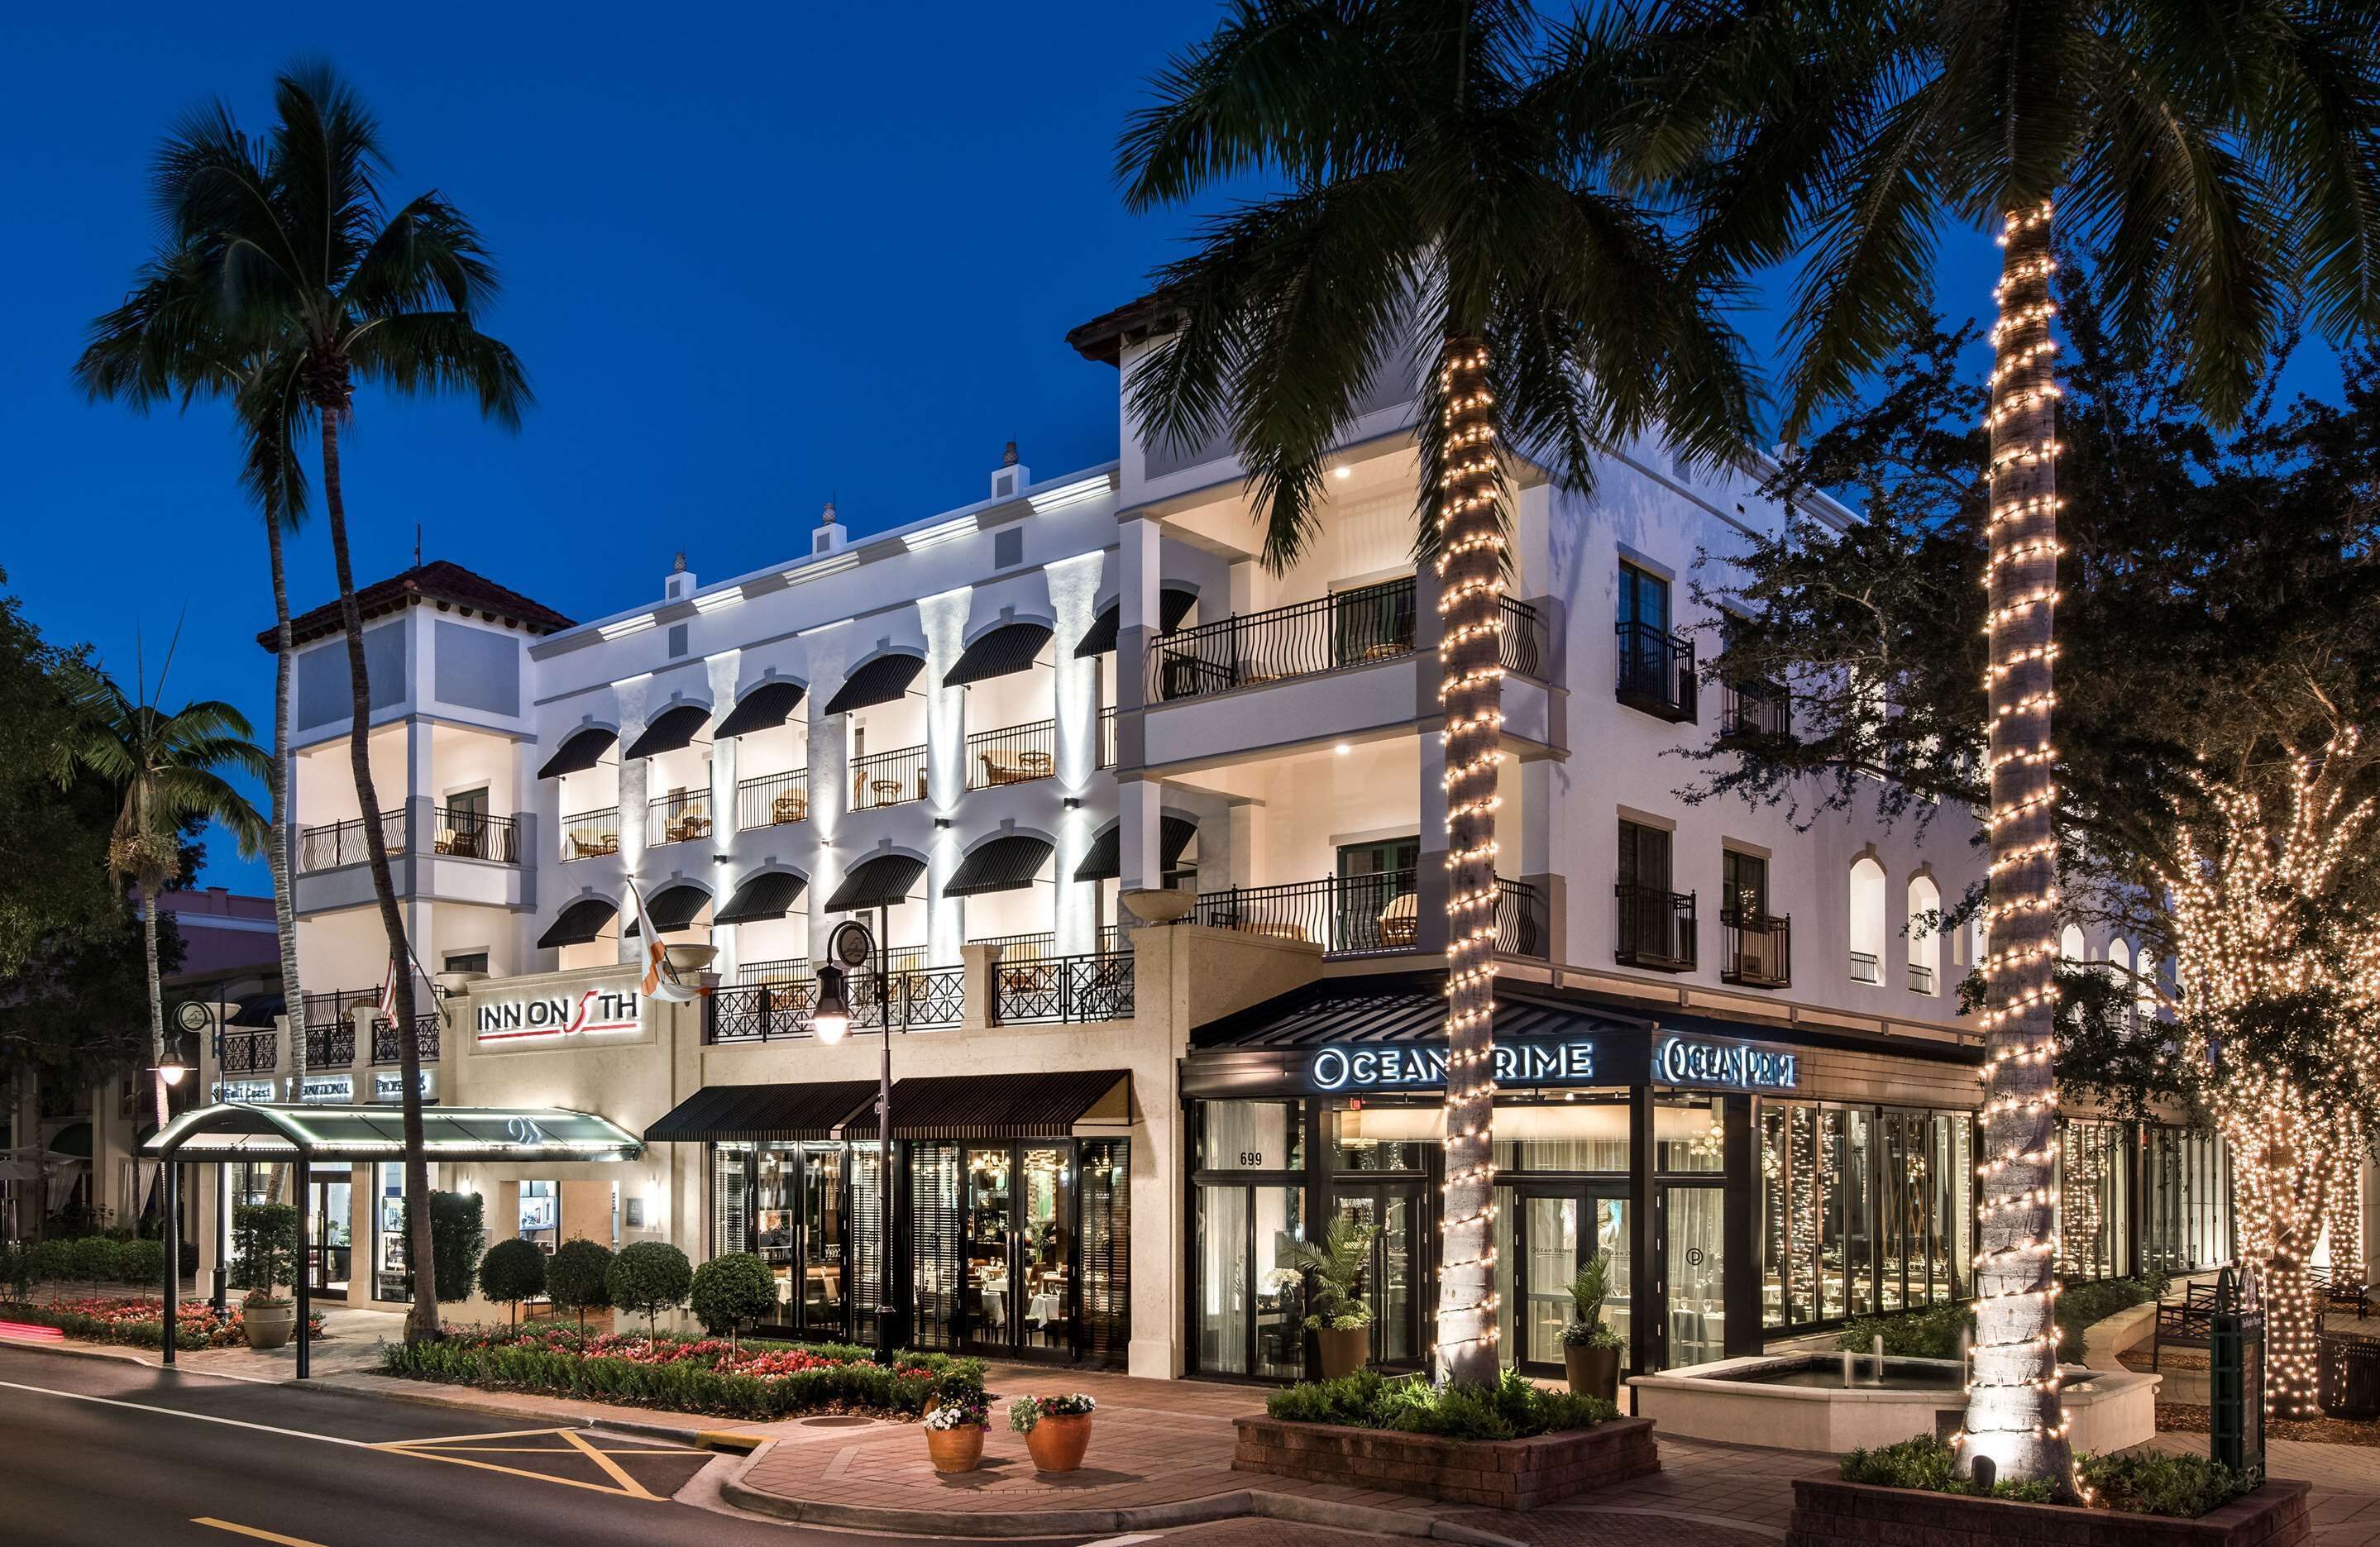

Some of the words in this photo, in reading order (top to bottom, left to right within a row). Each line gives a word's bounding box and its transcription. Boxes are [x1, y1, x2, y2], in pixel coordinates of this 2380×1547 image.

[477, 1003, 522, 1030] INN
[528, 999, 569, 1025] ON
[1312, 1045, 1450, 1090] OCEAN
[1493, 1042, 1594, 1080] RIME
[1663, 1036, 1740, 1086] OCEAN
[1240, 1152, 1262, 1166] 699
